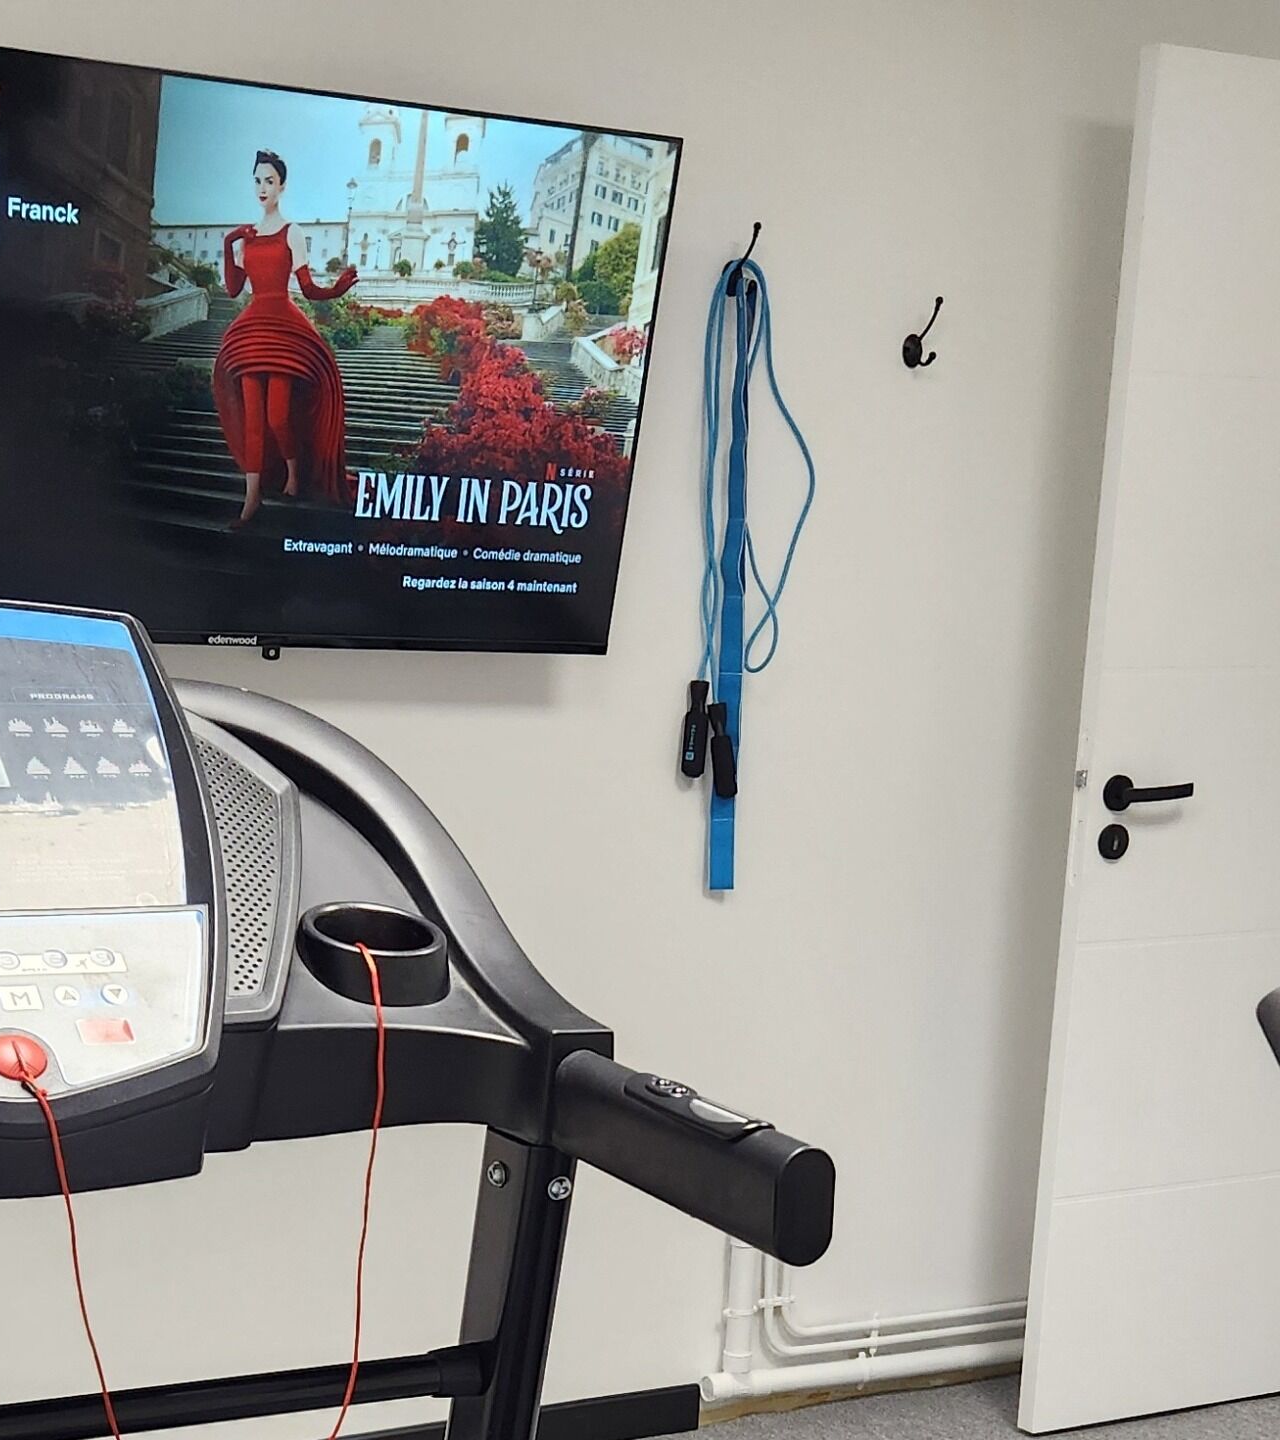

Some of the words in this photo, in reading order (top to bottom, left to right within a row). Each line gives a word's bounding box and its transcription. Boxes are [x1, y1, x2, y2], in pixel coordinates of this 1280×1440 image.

[7, 196, 79, 225] Franck
[354, 471, 451, 521] EMILY
[456, 477, 492, 525] IN
[497, 480, 593, 535] PARIS
[283, 538, 353, 556] Extravagant
[368, 542, 458, 561] Mélodramatique
[472, 547, 521, 561] Comédie
[523, 549, 582, 566] dramatique
[402, 575, 456, 591] Regardez
[458, 577, 468, 589] la
[470, 578, 505, 591] saison
[507, 579, 515, 591] 4
[516, 580, 578, 594] maintenant
[207, 634, 258, 646] edenwood
[29, 692, 95, 701] PROGRAMS
[10, 991, 31, 1006] M
